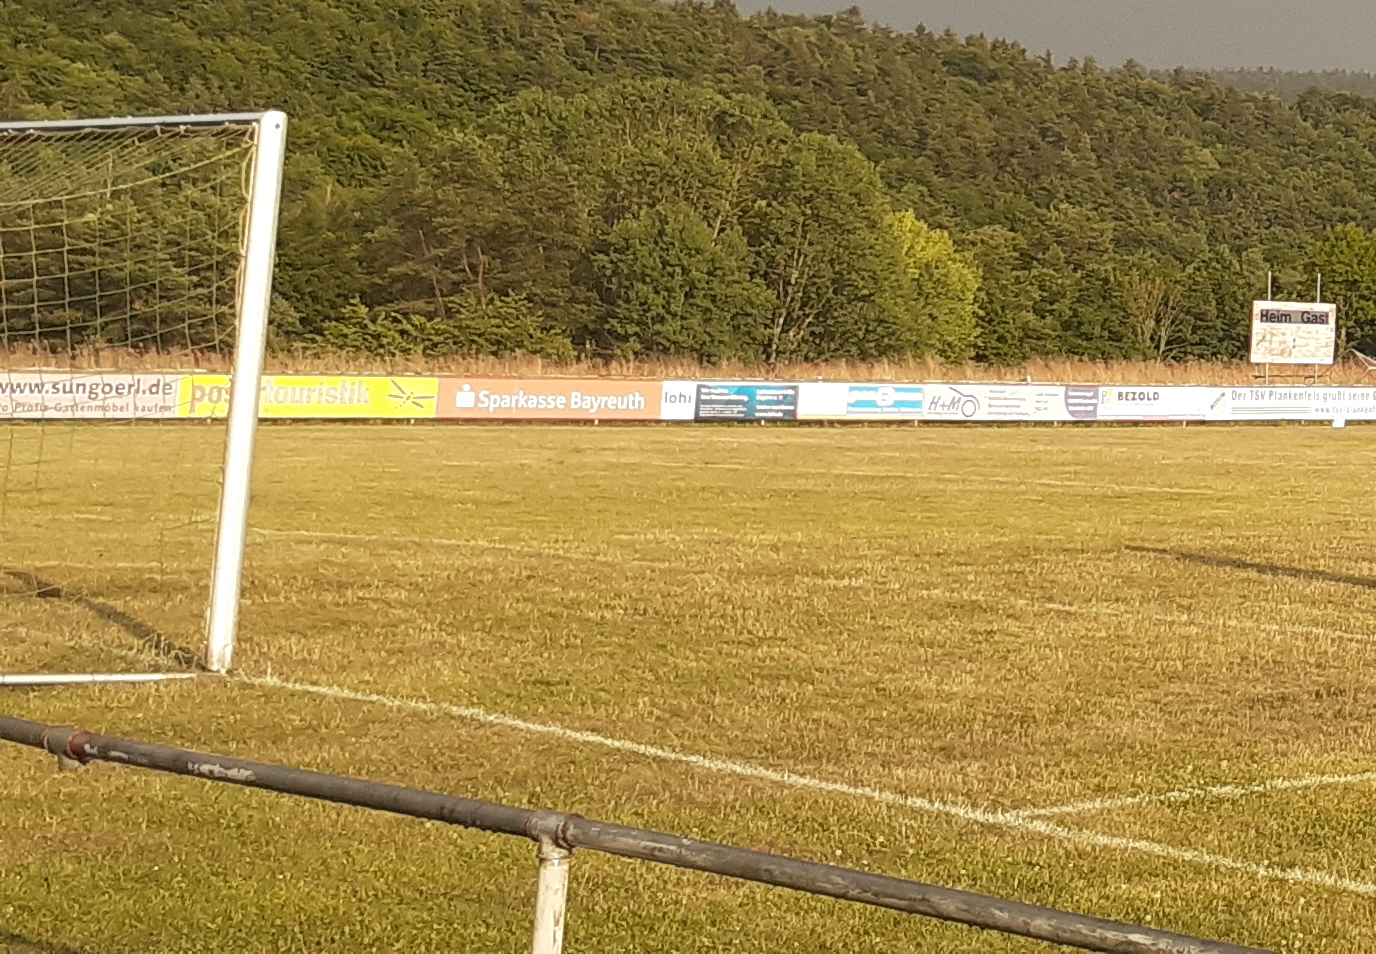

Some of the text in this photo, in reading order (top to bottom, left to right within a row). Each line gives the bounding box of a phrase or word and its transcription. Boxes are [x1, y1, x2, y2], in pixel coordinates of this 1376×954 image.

[1260, 310, 1329, 325] Heim Gast
[478, 390, 645, 413] Sparkasse Bayreuth
[1117, 390, 1160, 402] BEZOLD
[1231, 390, 1247, 401] Der
[1250, 390, 1266, 401] TSV
[1268, 390, 1320, 401] Plankenfels
